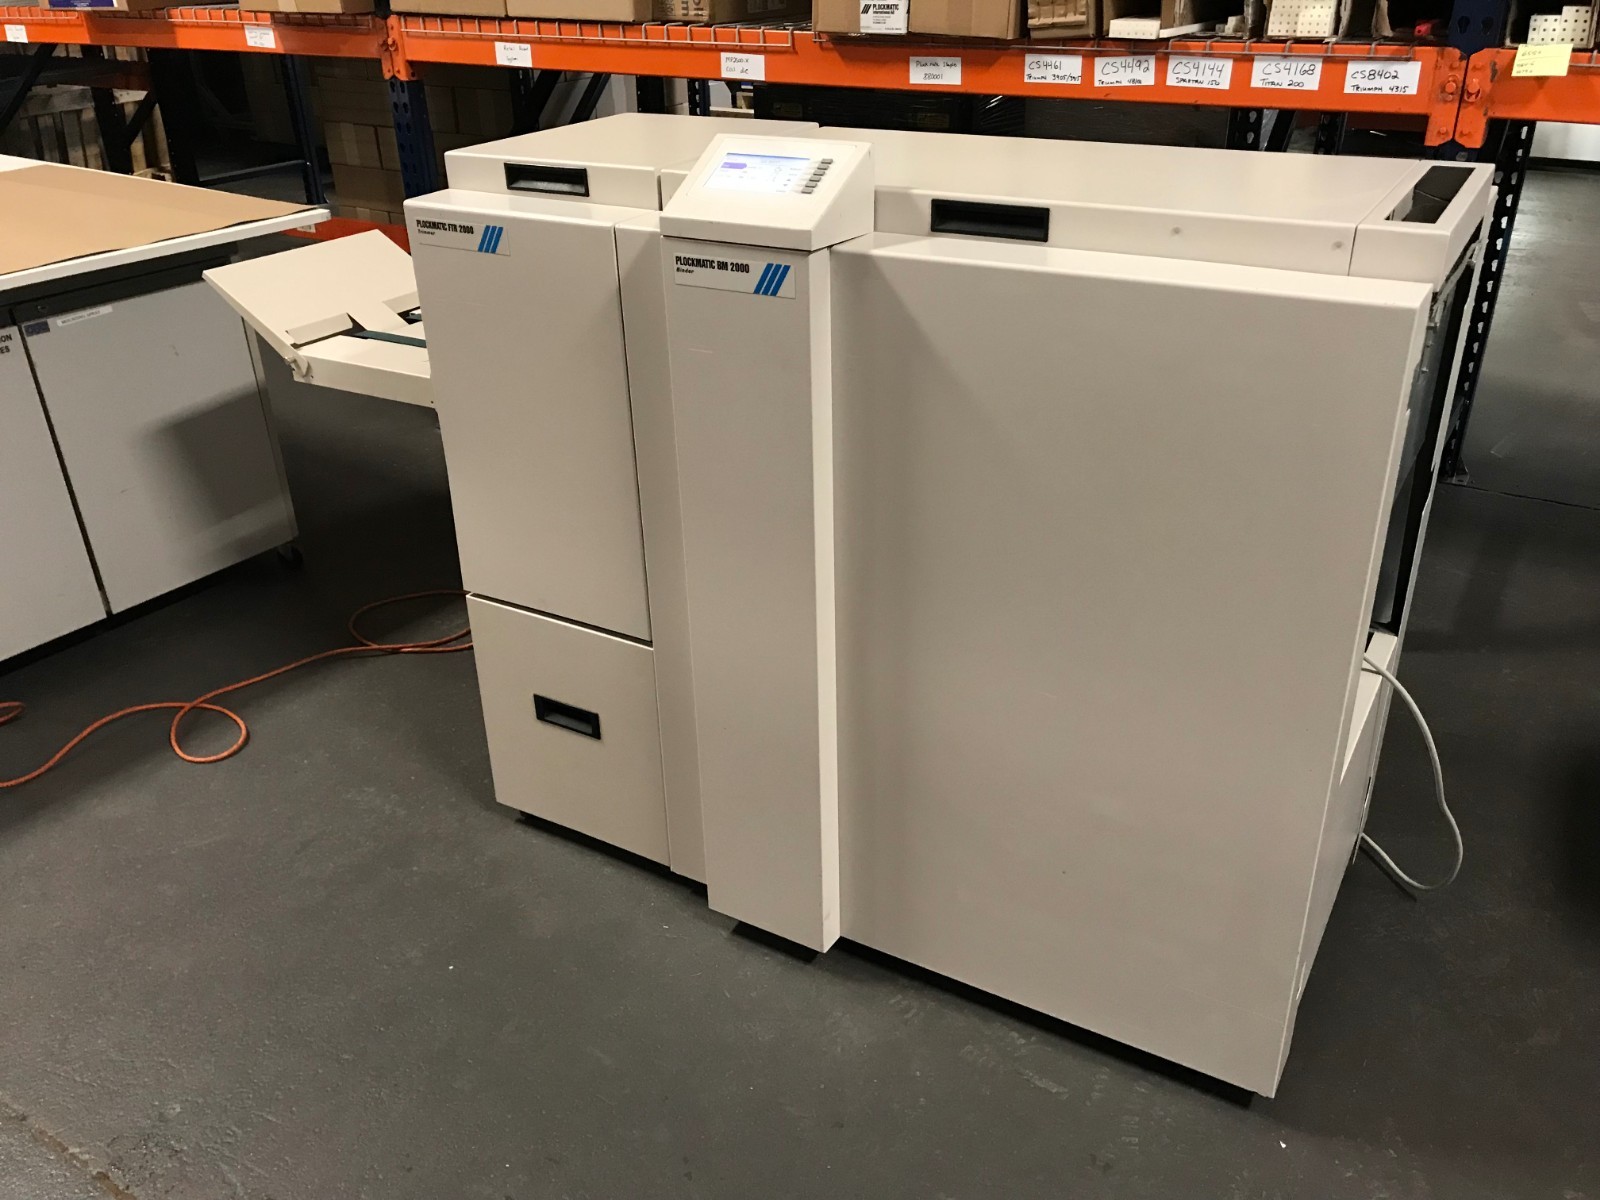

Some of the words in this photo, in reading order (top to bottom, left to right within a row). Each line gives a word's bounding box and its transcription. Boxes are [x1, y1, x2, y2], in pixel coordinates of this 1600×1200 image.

[1101, 58, 1150, 75] CS4492
[1172, 61, 1225, 78] CS4144
[1262, 62, 1316, 76] CS4168
[1351, 69, 1400, 81] CS8402
[1287, 79, 1304, 88] 200
[1389, 85, 1409, 93] 4315
[416, 219, 447, 231] PLOCKMATIC
[459, 224, 474, 235] 2000
[675, 255, 715, 270] PLOCKMATIC
[716, 260, 728, 271] BM
[730, 262, 750, 274] 2000
[0, 333, 13, 343] ON
